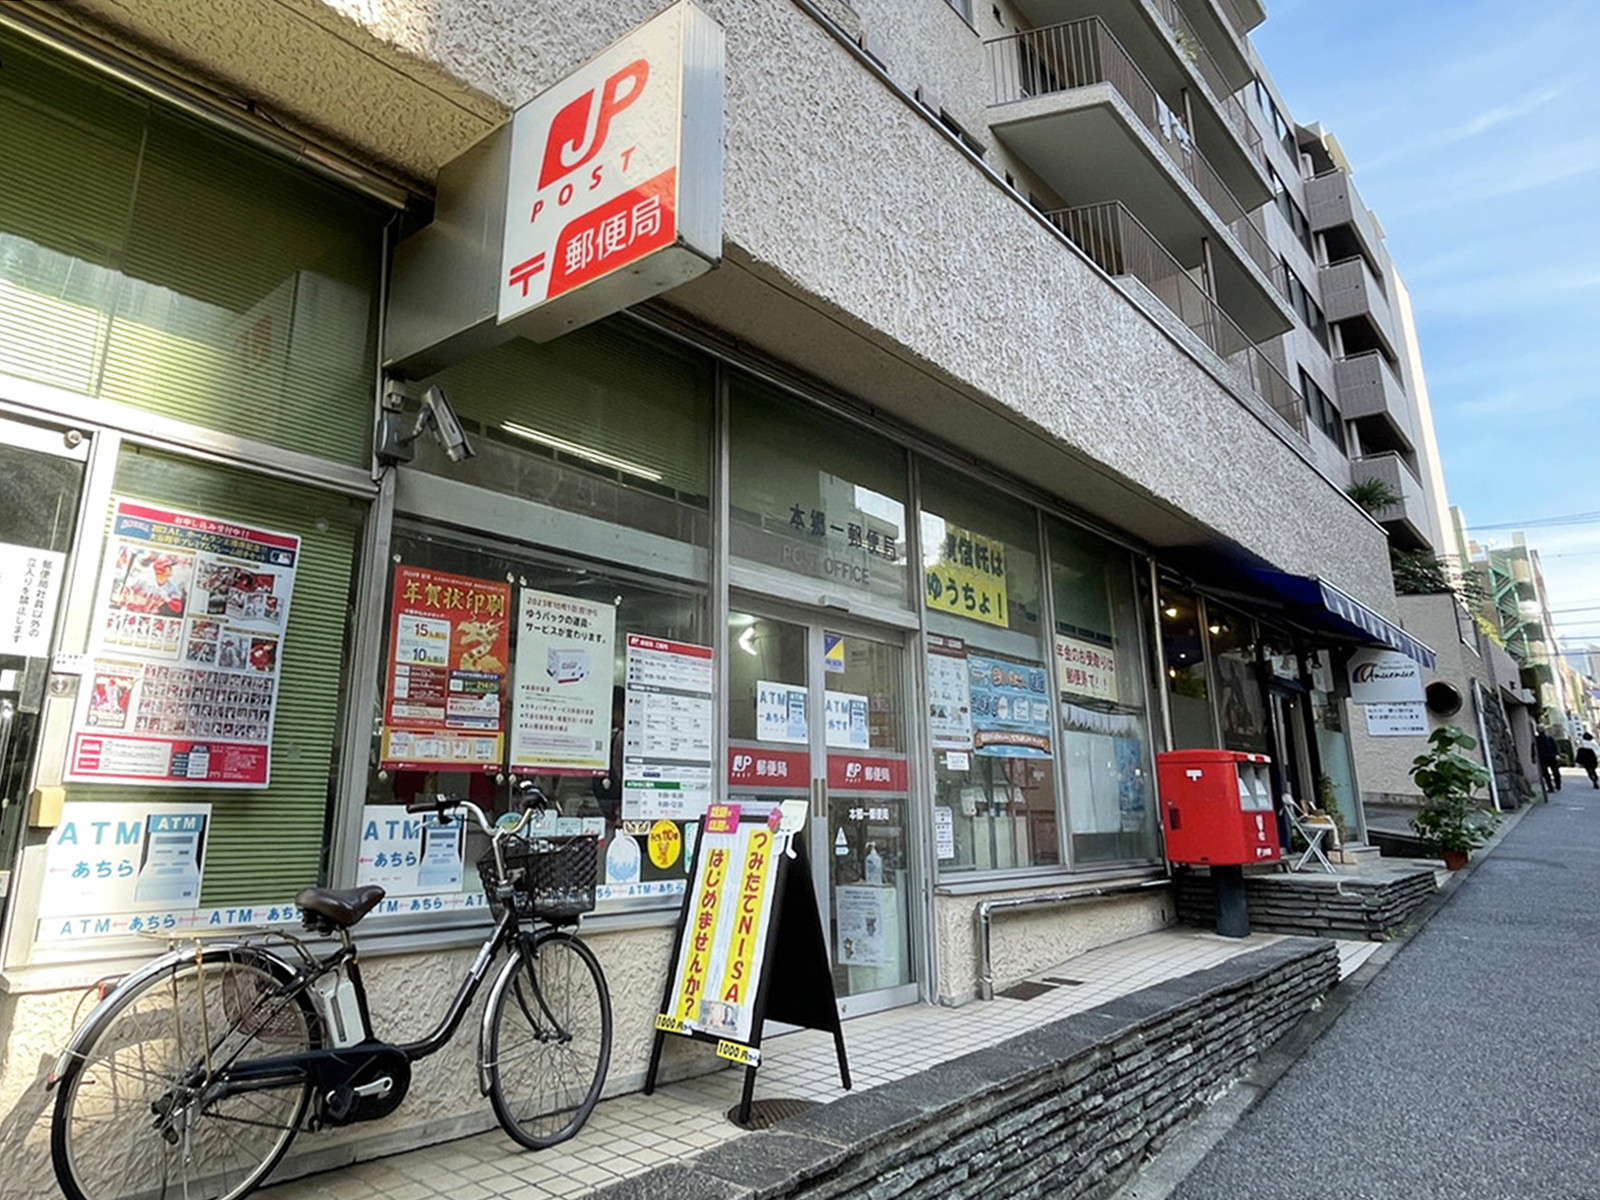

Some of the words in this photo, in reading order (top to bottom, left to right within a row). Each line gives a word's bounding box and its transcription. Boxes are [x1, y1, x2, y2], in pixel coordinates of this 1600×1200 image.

[539, 59, 650, 191] JP
[531, 147, 635, 223] POST
[565, 195, 660, 275] 郵便局
[789, 503, 896, 561] 本郷一郵便局
[824, 558, 870, 585] OFFICE
[402, 579, 505, 617] 年賀状印刷
[760, 690, 786, 706] ATM
[825, 700, 849, 713] ATM
[756, 760, 787, 777] 郵便局
[865, 767, 890, 782] 郵便局
[57, 821, 141, 845] ATM
[158, 816, 196, 829] ATM
[364, 820, 420, 840] ATM
[71, 859, 134, 879] あちら
[374, 851, 417, 867] あちら
[628, 883, 651, 896] ATM
[410, 898, 443, 911] あちら
[60, 918, 111, 935] ATM
[129, 914, 176, 931] あちら
[209, 908, 253, 925] ATM
[724, 832, 768, 1003] つみたてNISA
[684, 849, 724, 1017] はじめませんか?
